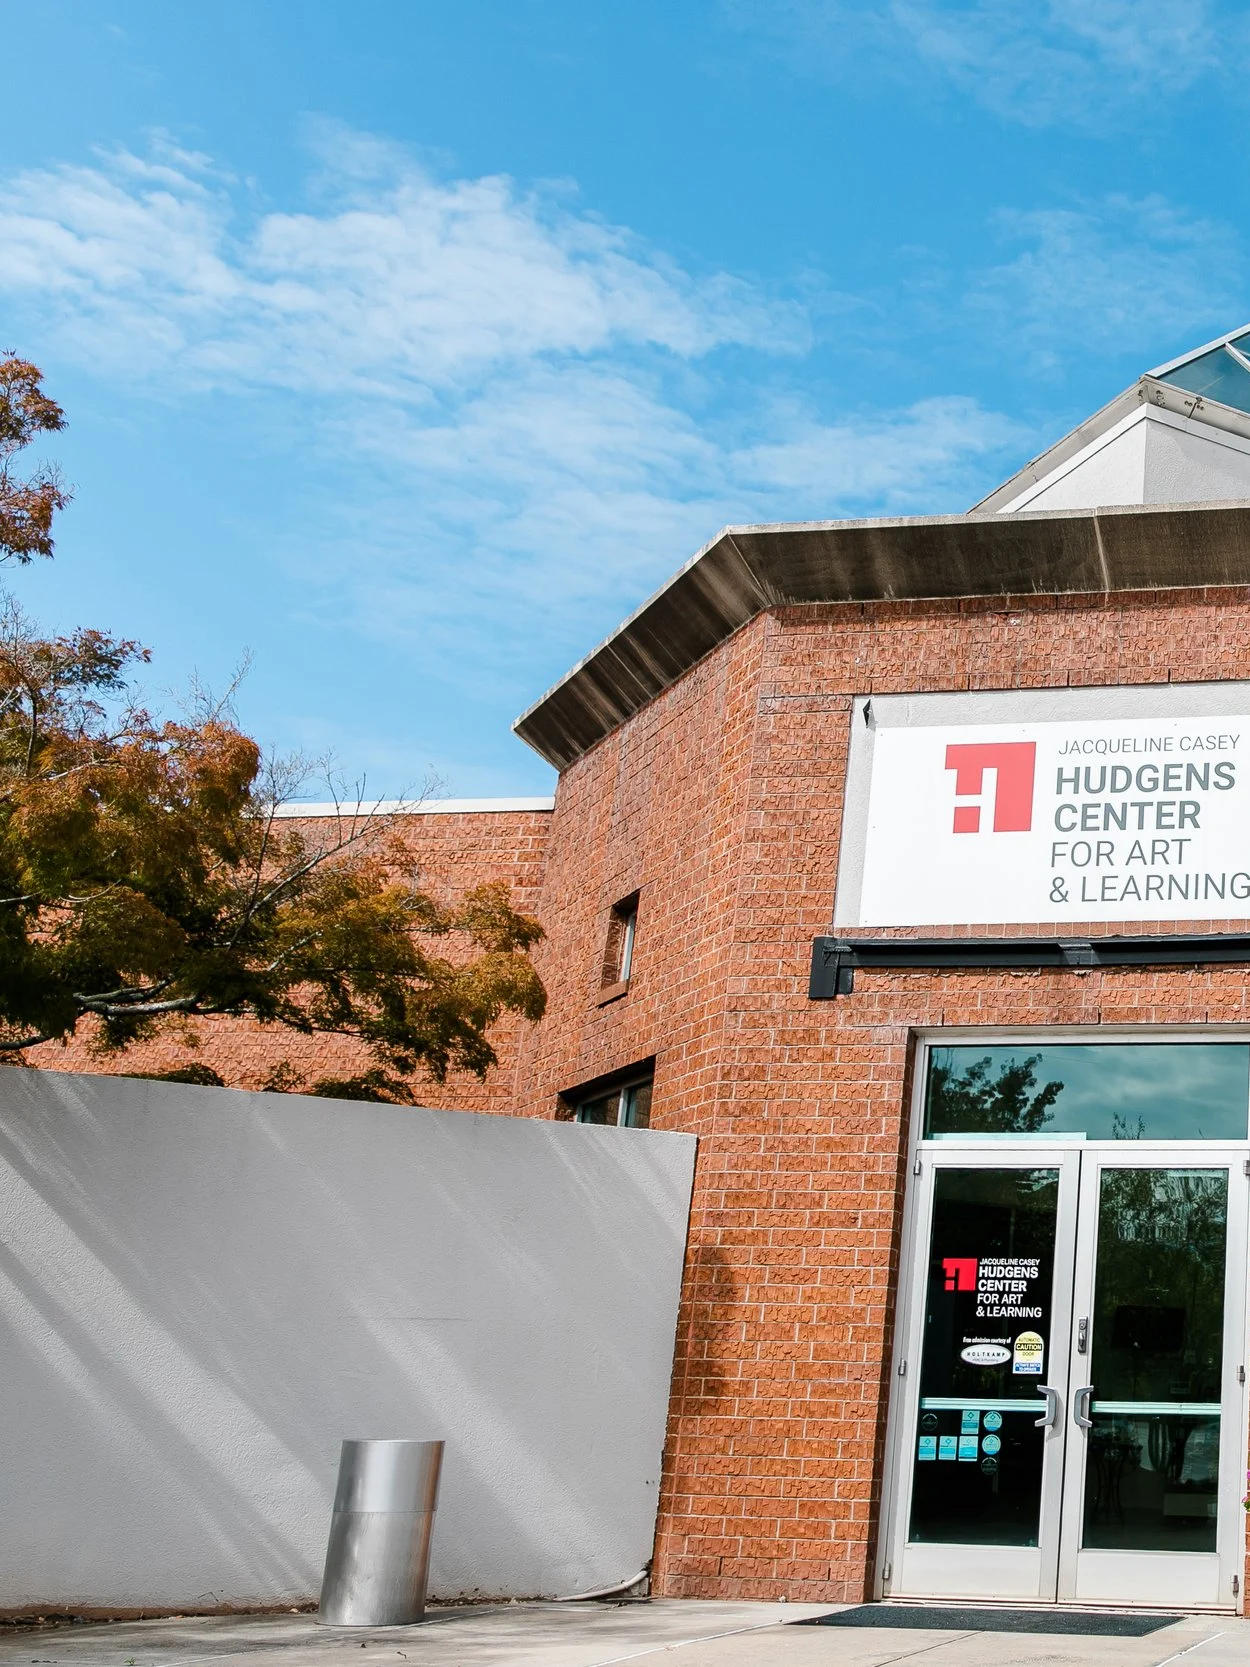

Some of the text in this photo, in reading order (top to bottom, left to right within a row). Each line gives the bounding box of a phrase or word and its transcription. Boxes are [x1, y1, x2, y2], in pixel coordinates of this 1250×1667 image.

[1058, 734, 1240, 755] JACQUELINE CASEY
[1056, 761, 1236, 795] HUDGENS
[1054, 800, 1201, 832] CENTER
[1051, 838, 1191, 867] FOR ART
[1049, 872, 1250, 903] & LEARNING
[1019, 1258, 1041, 1266] CASEY
[978, 1266, 1039, 1279] HUDGENS
[978, 1279, 1028, 1292] CENTER
[977, 1293, 1024, 1305] FOR ART
[976, 1306, 1042, 1318] & LEARNING
